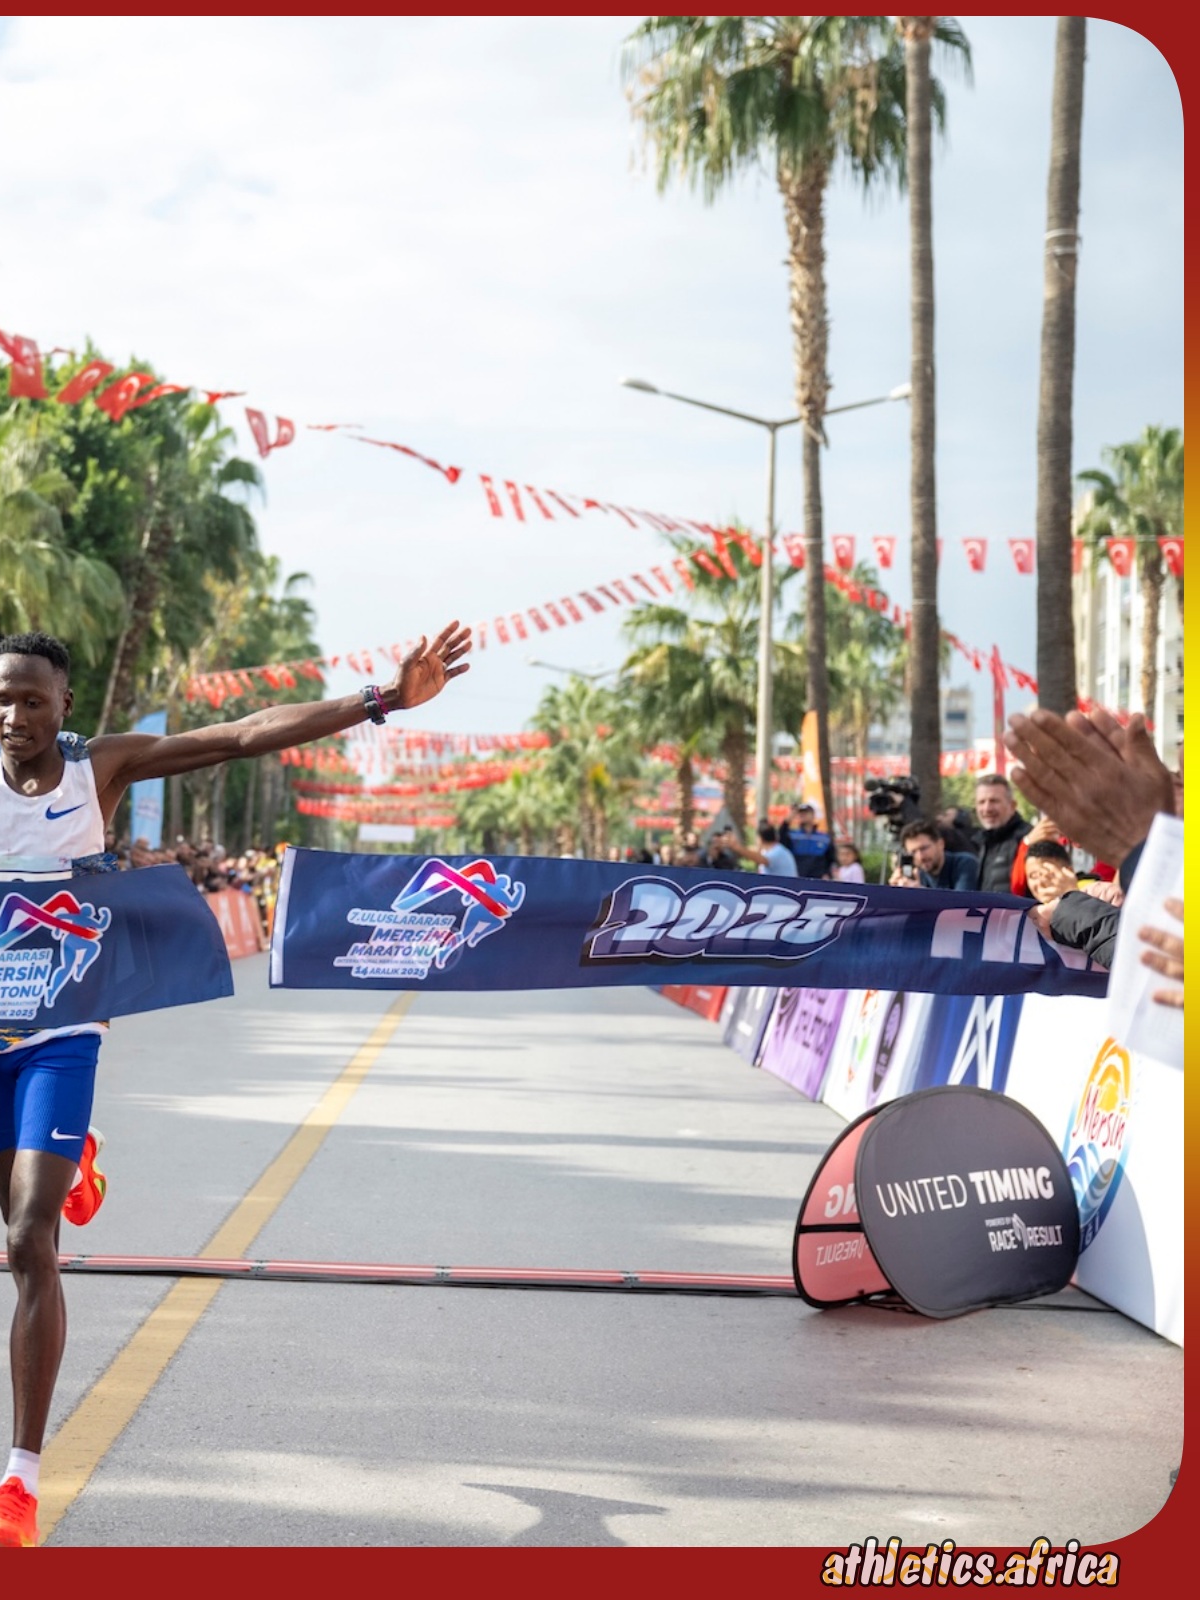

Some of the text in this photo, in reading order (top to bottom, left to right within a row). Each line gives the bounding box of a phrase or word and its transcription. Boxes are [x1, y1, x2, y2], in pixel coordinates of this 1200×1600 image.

[350, 911, 453, 926] 7.ULUSLARARASI
[611, 882, 859, 945] 2025
[350, 945, 437, 957] MARATONU
[354, 967, 368, 976] 14
[400, 968, 426, 977] 2025
[9, 1008, 34, 1018] 2025
[876, 1174, 968, 1218] UNITED
[969, 1166, 1055, 1205] TIMING
[988, 1228, 1018, 1252] RACE
[1026, 1224, 1063, 1247] RESULT
